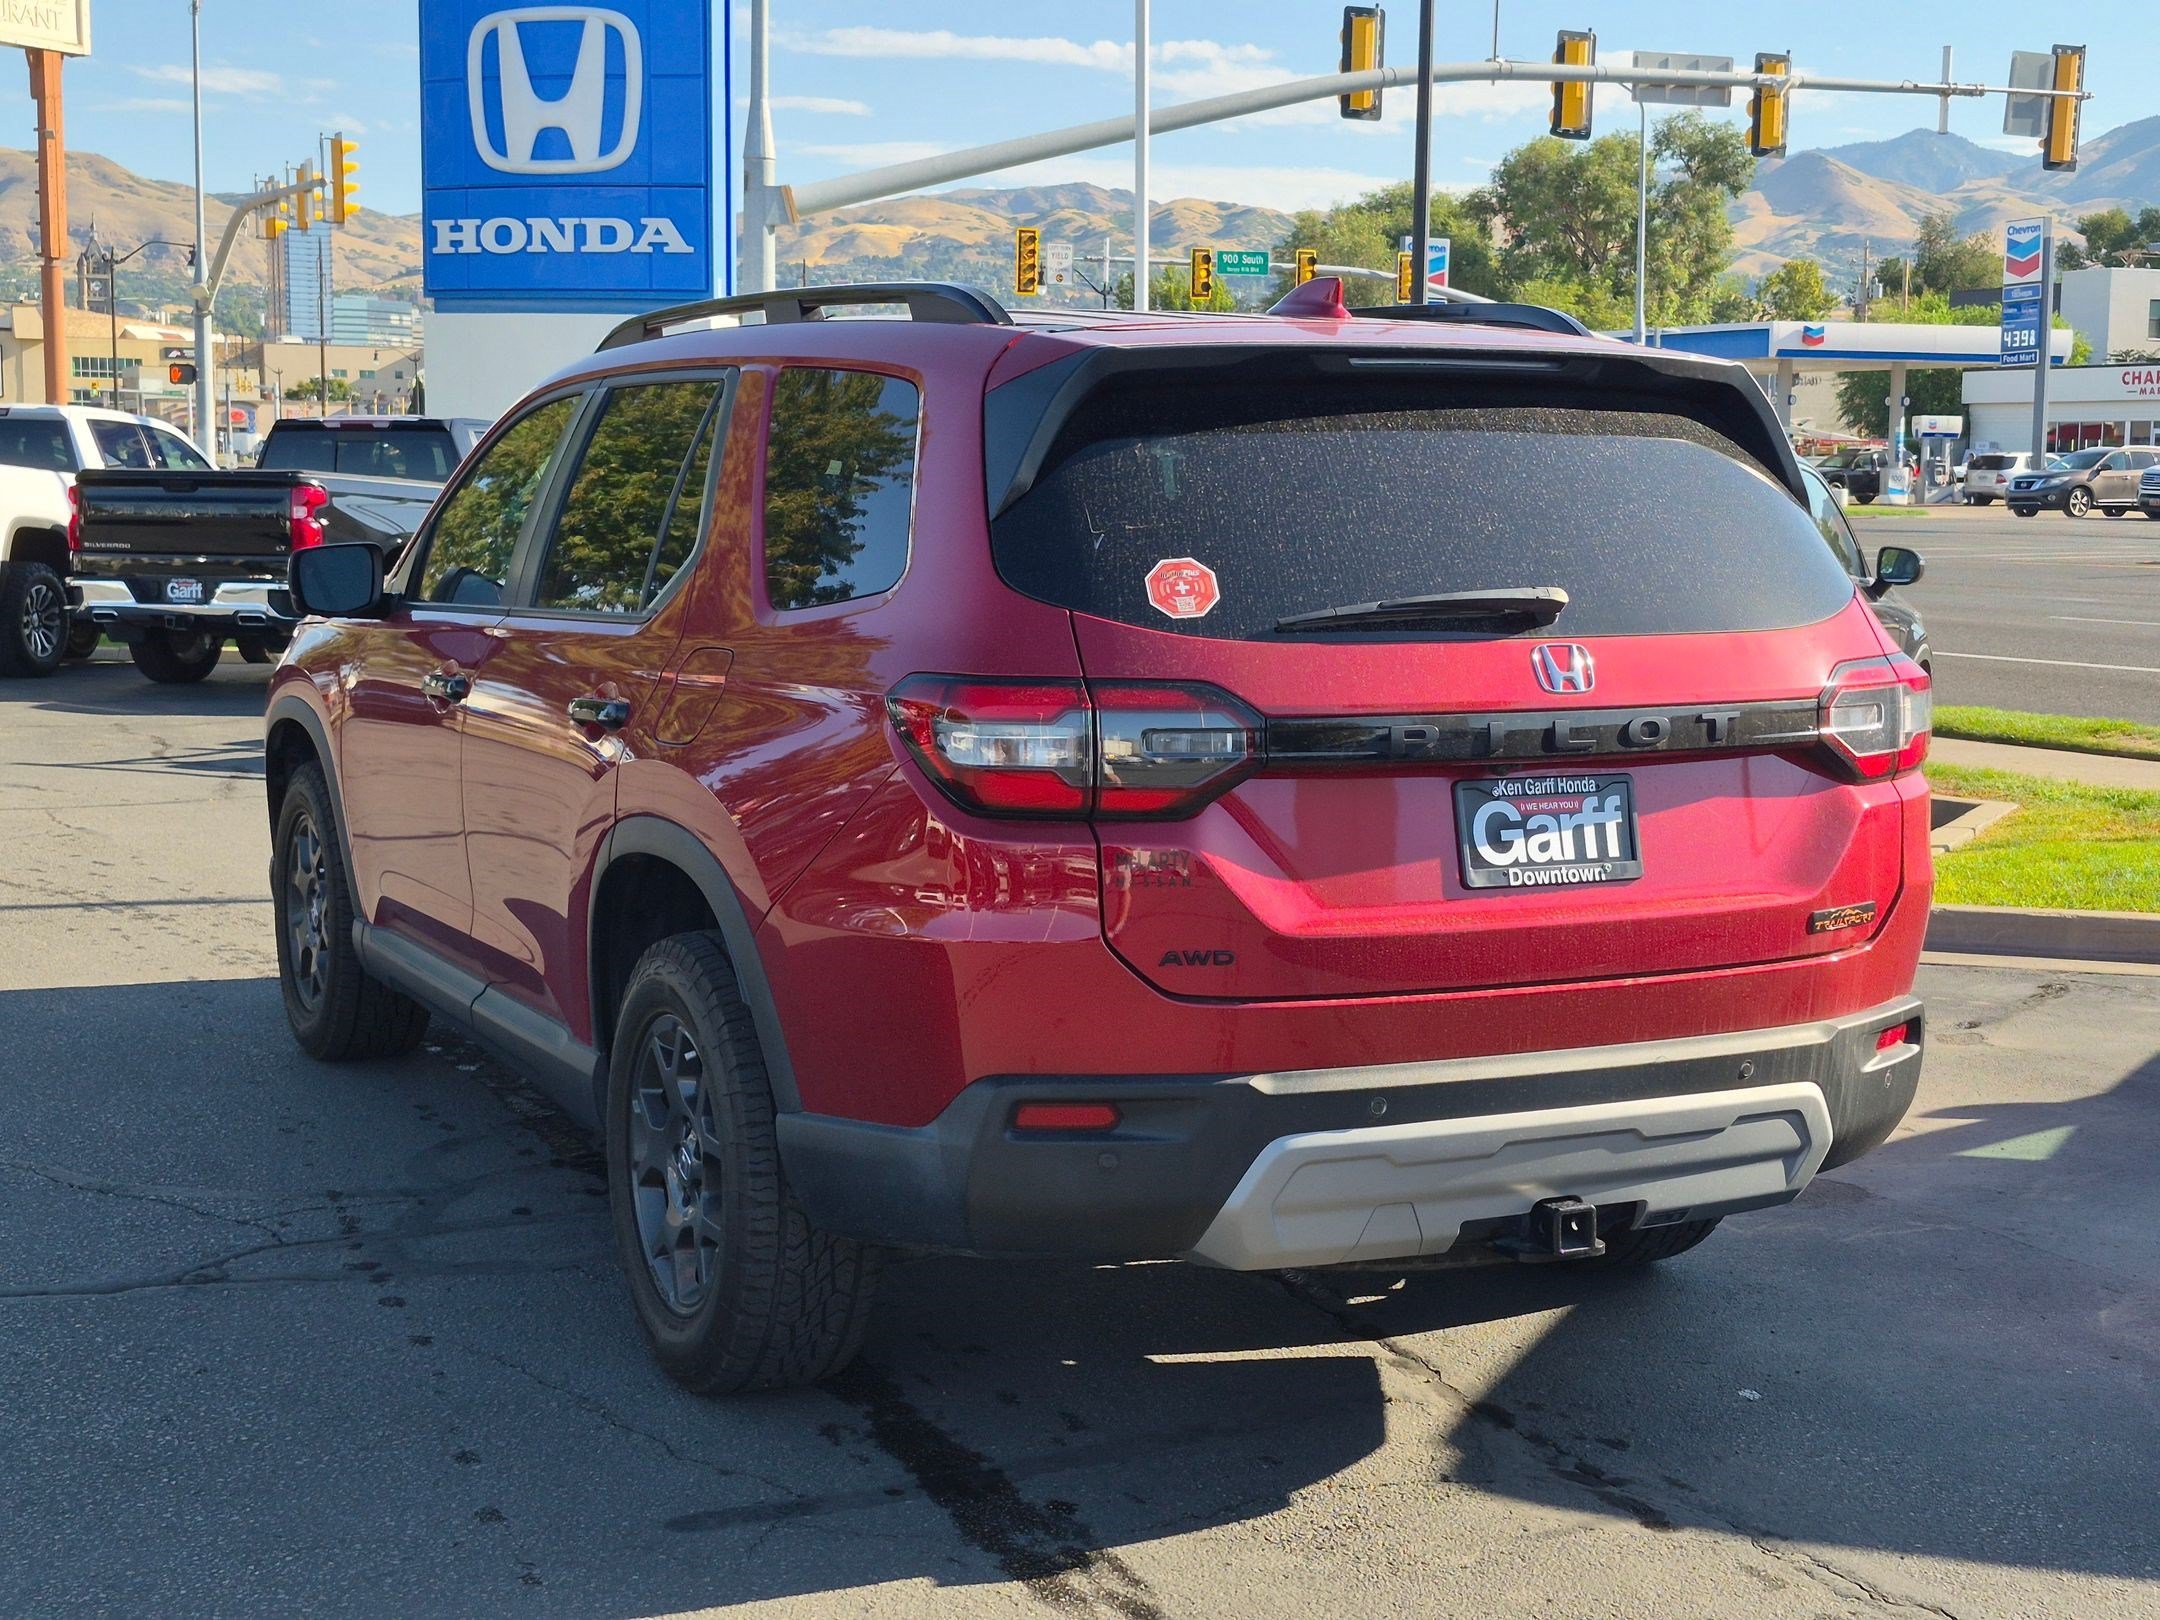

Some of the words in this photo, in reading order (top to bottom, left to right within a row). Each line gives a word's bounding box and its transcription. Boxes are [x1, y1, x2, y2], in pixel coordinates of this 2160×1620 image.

[431, 217, 694, 254] HONDA
[2007, 225, 2041, 236] Chevron
[1051, 252, 1069, 260] YIELD
[1222, 254, 1239, 264] 900
[1241, 254, 1264, 265] South
[2003, 354, 2018, 363] Food
[2019, 352, 2035, 362] Mart
[83, 541, 131, 549] SILVERADO
[166, 580, 203, 599] Garff
[1390, 711, 1741, 751] PILOT
[1499, 780, 1522, 797] Ken
[1525, 777, 1555, 796] Garff
[1557, 776, 1596, 794] Honda
[1526, 802, 1538, 811] WE
[1539, 801, 1558, 810] HEAR
[1559, 800, 1574, 809] YOU
[1473, 795, 1623, 866] Garff
[1115, 876, 1192, 888] NSSAN
[1509, 866, 1607, 886] Downtown
[1158, 950, 1236, 967] AWD
